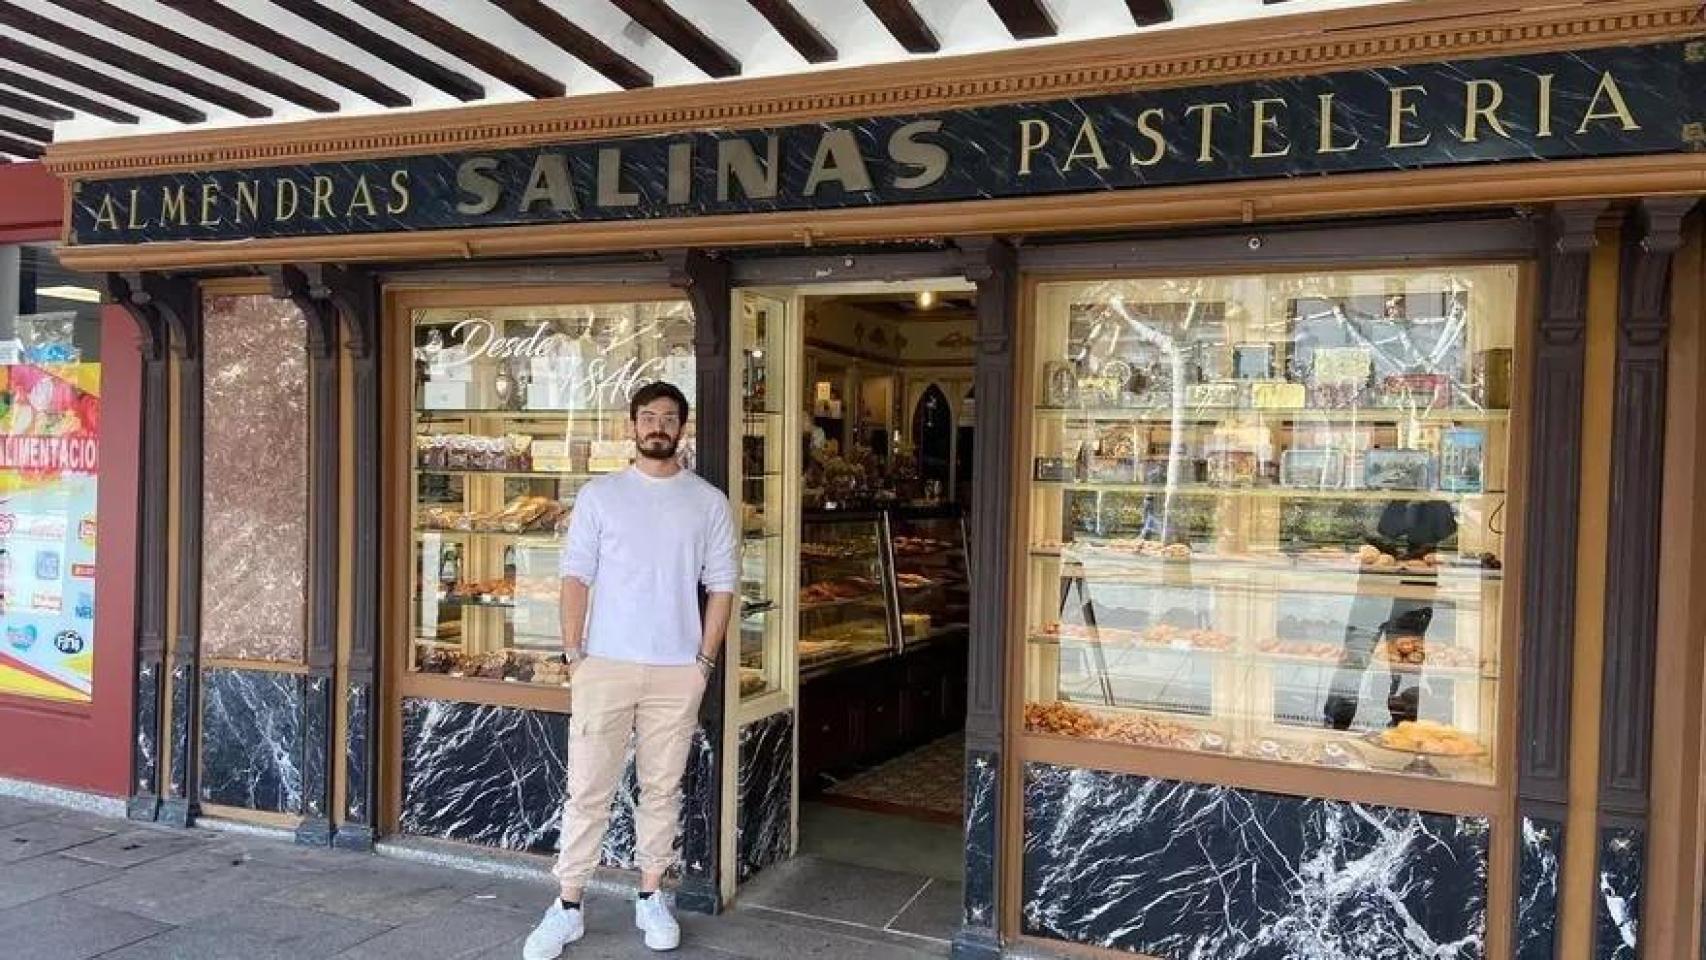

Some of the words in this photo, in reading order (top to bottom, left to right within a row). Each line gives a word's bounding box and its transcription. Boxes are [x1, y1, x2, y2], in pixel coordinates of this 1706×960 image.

[93, 170, 410, 231] ALMENDRAS
[456, 120, 949, 216] SALINAS
[1017, 71, 1643, 176] PASTELERIA
[436, 317, 553, 367] Desde
